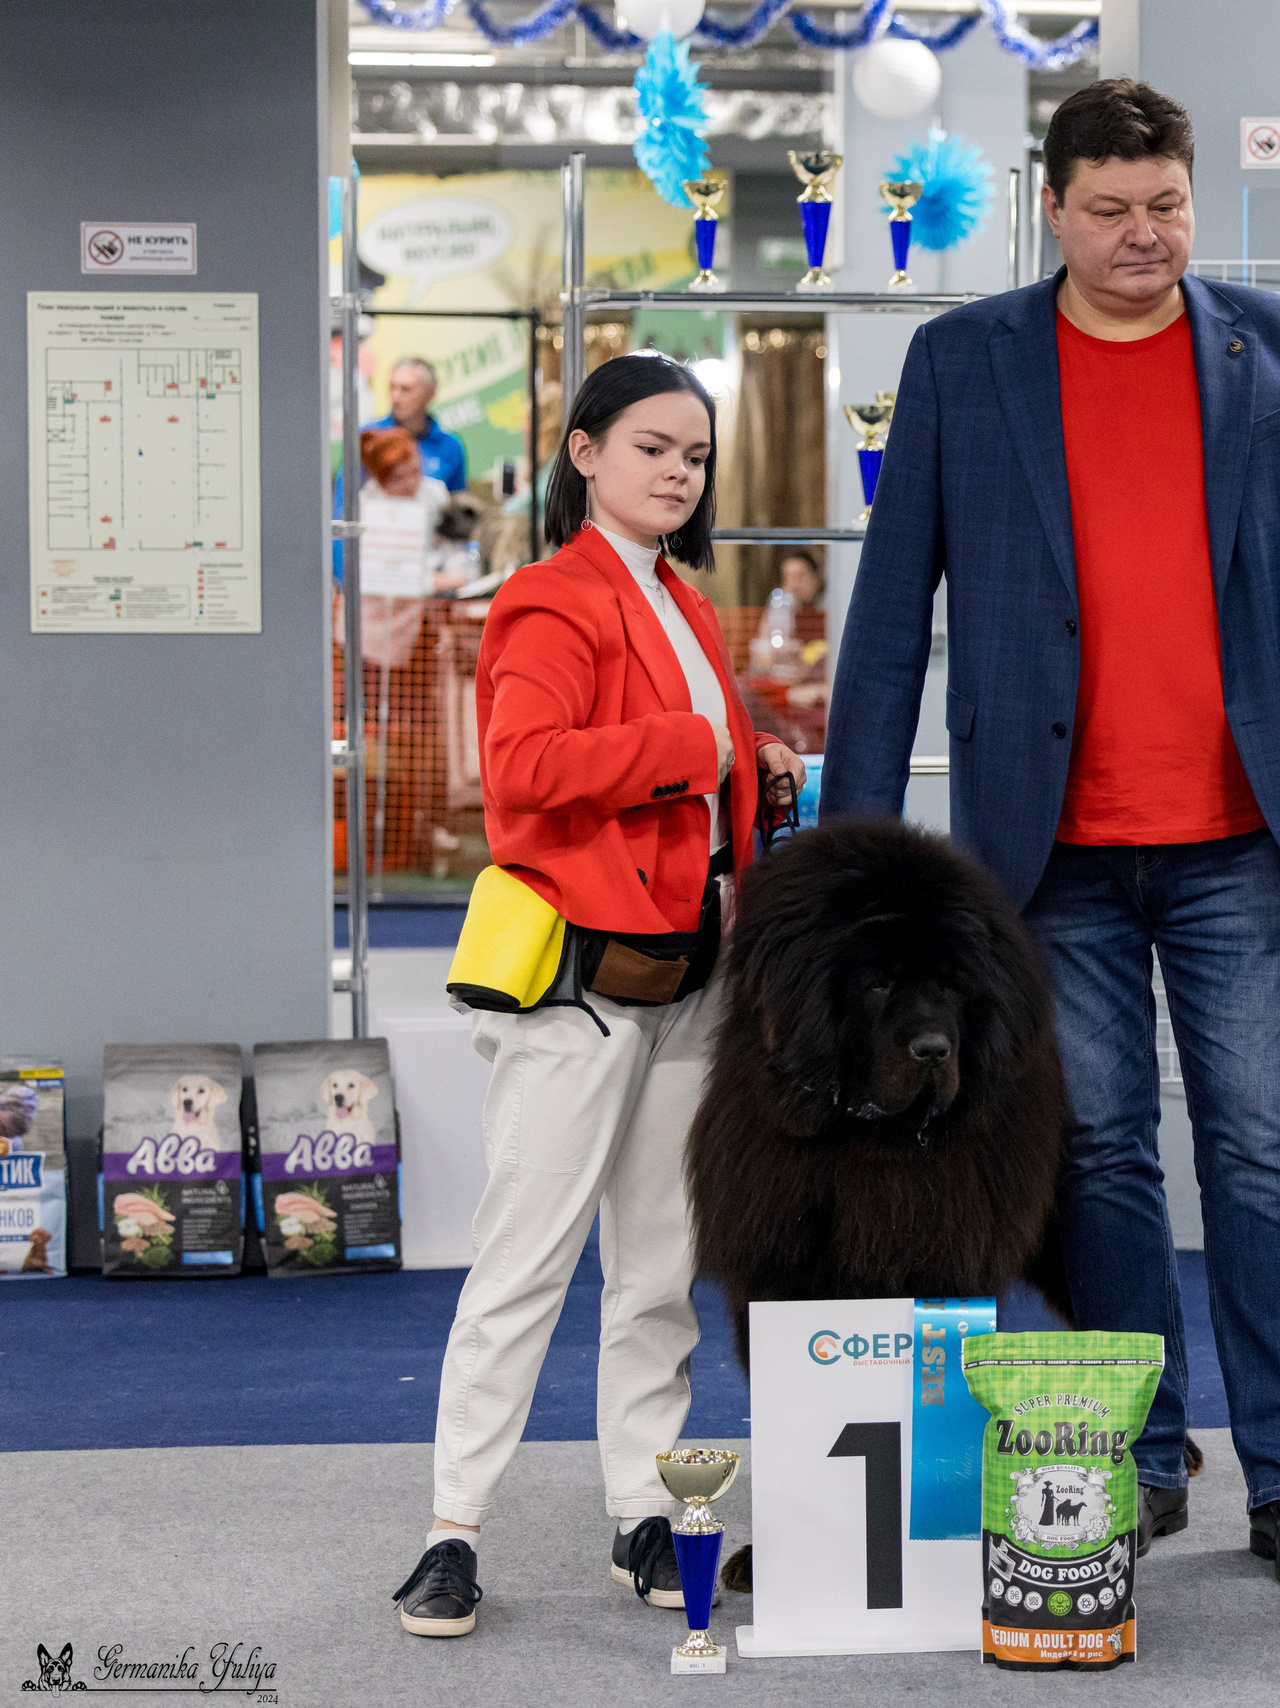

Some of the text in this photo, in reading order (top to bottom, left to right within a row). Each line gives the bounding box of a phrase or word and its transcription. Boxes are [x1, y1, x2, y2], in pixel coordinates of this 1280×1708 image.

[128, 235, 189, 246] НЕ КУРИТЬ
[853, 1358, 911, 1366] ВЫСТАВОЧНЫЙ
[921, 1323, 946, 1407] BEST
[1013, 1394, 1111, 1418] SUPER PREMIUM
[997, 1419, 1129, 1465] ZooRing
[1056, 1485, 1084, 1496] ZooRing
[826, 1421, 903, 1610] 1
[1018, 1559, 1103, 1581] DOG FOOD
[1034, 1632, 1074, 1649] ADULT
[1078, 1633, 1104, 1649] DOG
[1040, 1649, 1077, 1660] Индейка
[1087, 1651, 1103, 1659] рис
